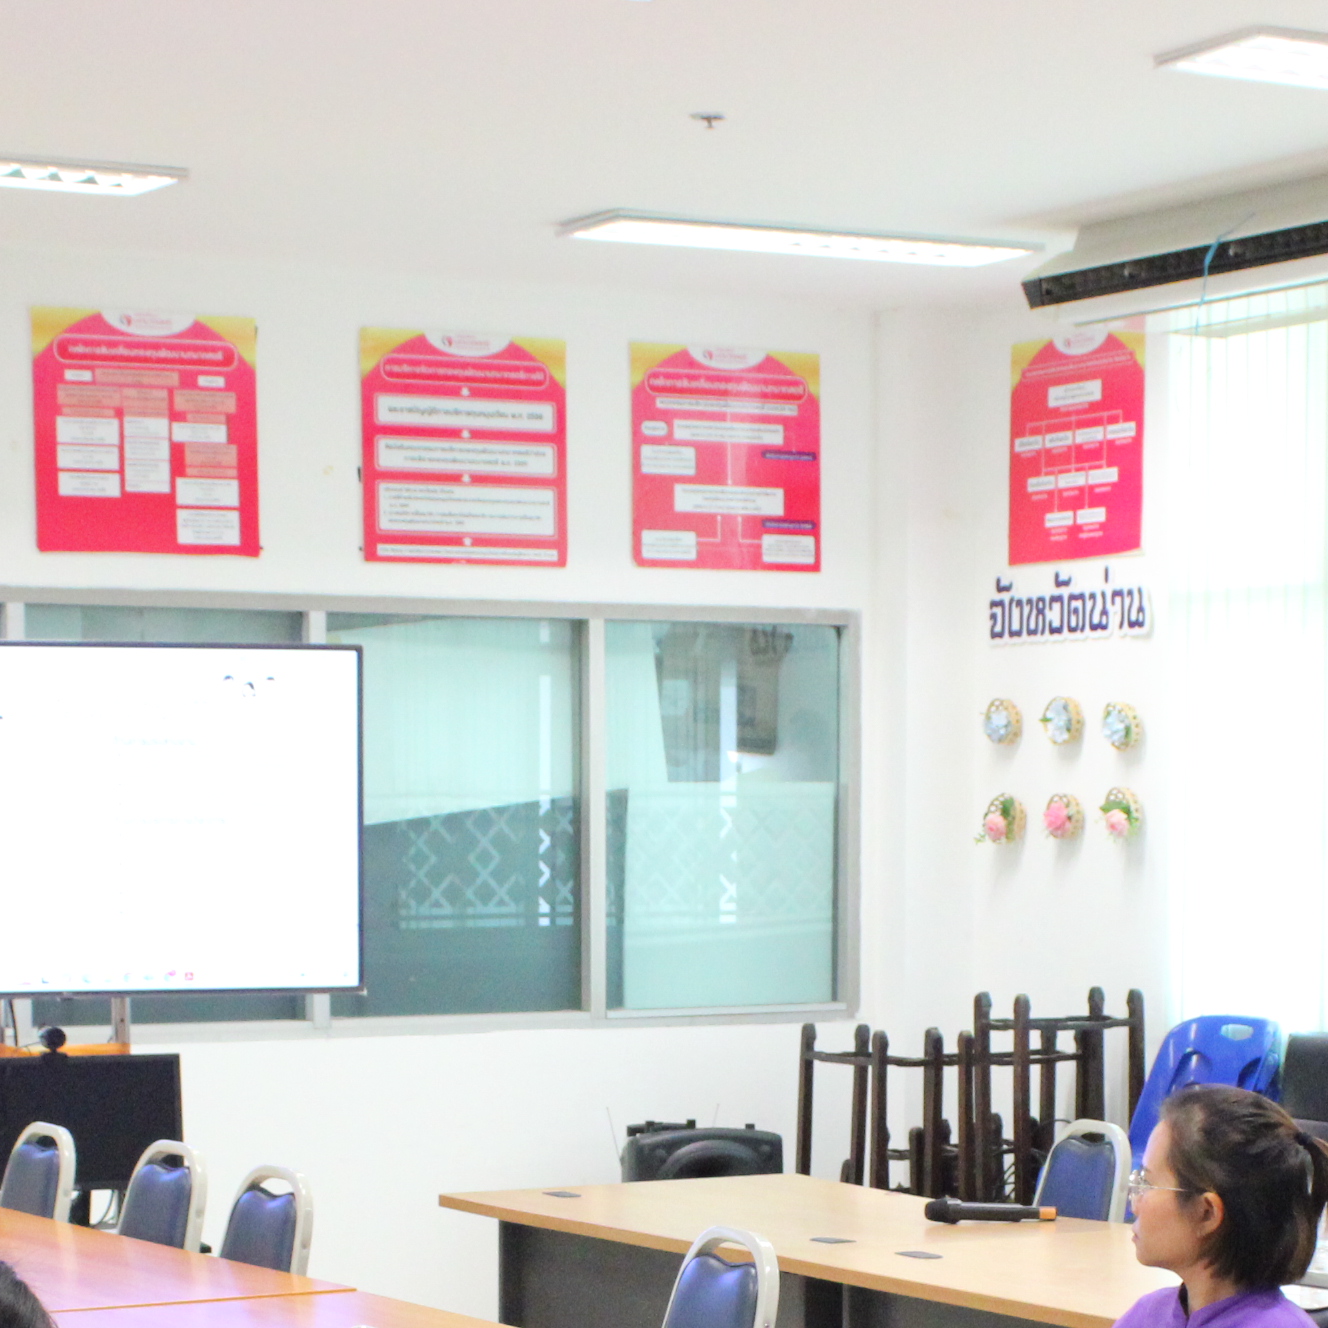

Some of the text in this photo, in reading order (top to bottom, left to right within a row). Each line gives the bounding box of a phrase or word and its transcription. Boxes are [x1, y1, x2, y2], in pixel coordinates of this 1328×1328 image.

[989, 566, 1146, 640] จังหวัดน่าน
